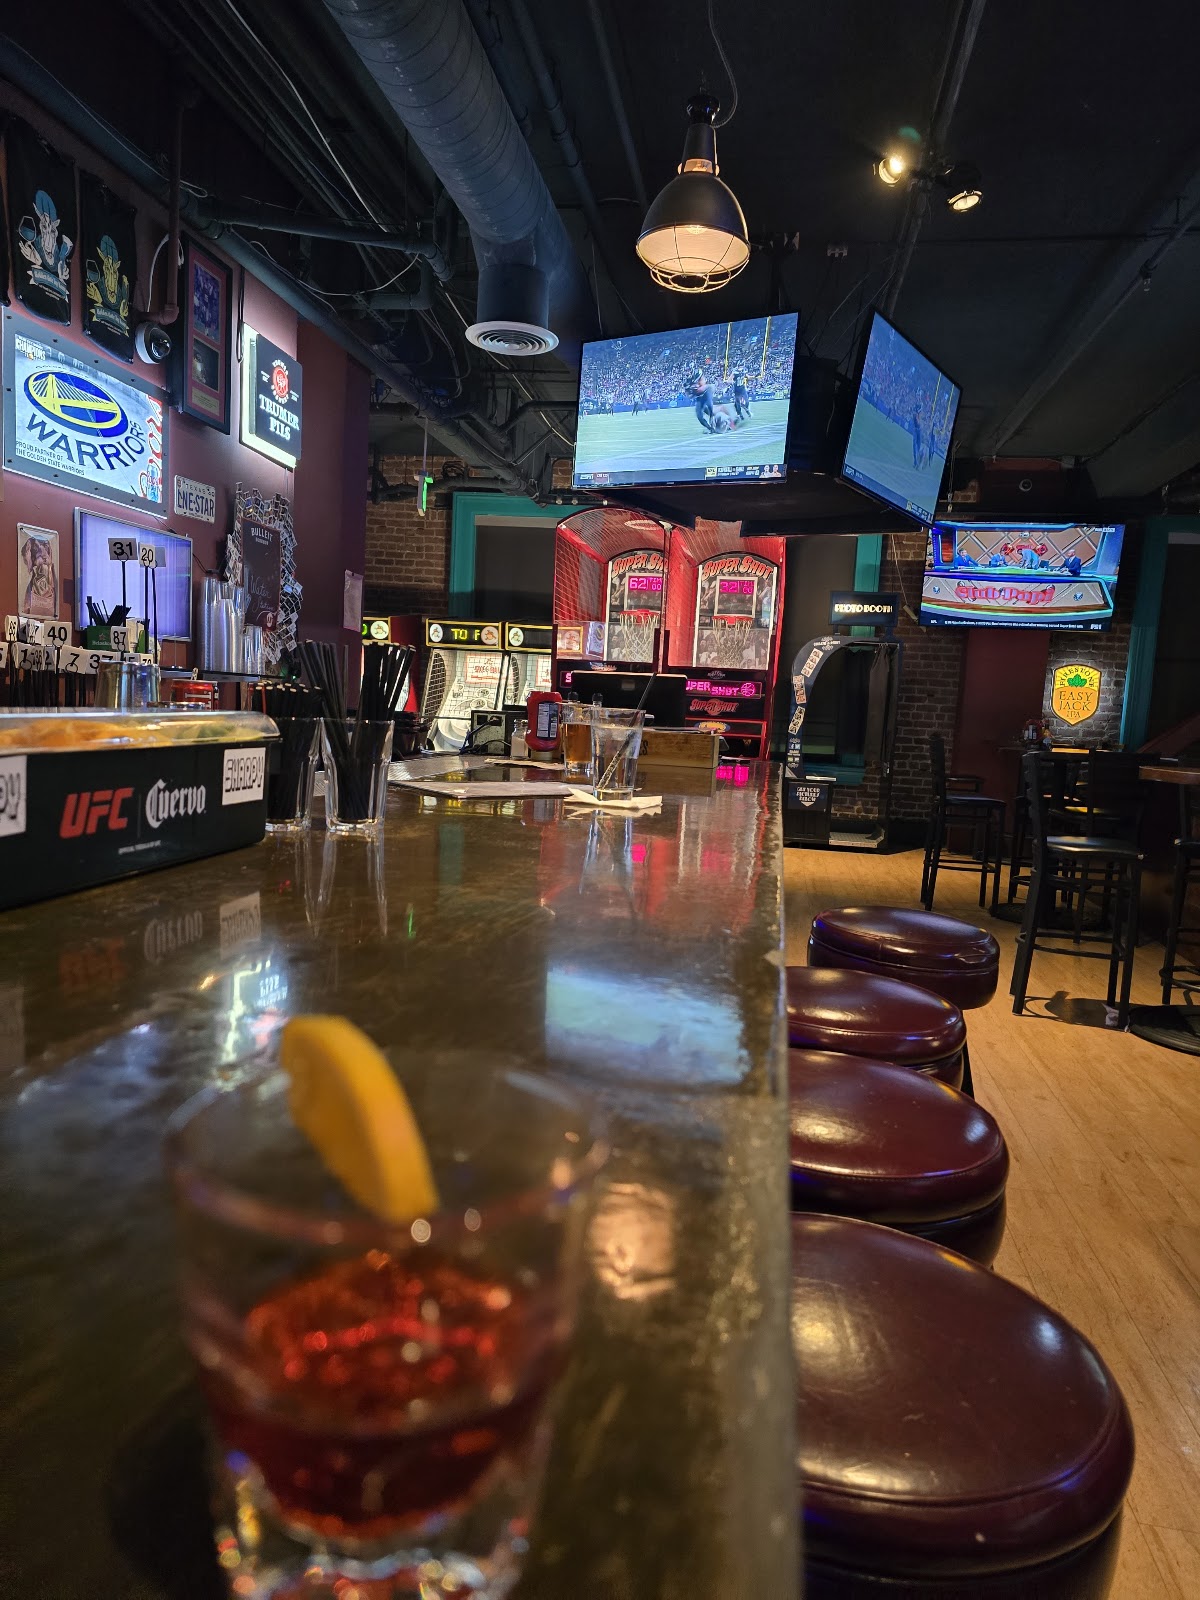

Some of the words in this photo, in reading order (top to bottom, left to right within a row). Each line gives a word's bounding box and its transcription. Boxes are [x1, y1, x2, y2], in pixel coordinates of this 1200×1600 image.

[258, 394, 300, 430] TRUMER
[269, 416, 291, 440] PILS
[16, 441, 33, 451] PROUD
[26, 420, 147, 470] WARRIORS
[16, 447, 25, 456] THE
[48, 458, 61, 468] STATE
[250, 527, 273, 542] BULLEIT
[113, 541, 133, 556] 31
[141, 547, 154, 563] 20
[611, 555, 648, 579] SUPER
[702, 557, 741, 581] SUPER
[739, 556, 774, 581] SHOT
[629, 577, 647, 589] 62
[720, 581, 738, 593] 32
[834, 603, 863, 613] PHOTO
[864, 604, 892, 613] BOOTH
[47, 625, 68, 642] 40
[112, 630, 127, 646] 87
[451, 628, 467, 640] TO
[70, 652, 80, 667] 7
[1060, 667, 1095, 687] FIRESTONE
[711, 686, 739, 696] SHOT
[1059, 690, 1093, 702] EASY
[1057, 700, 1092, 712] JACK
[1066, 710, 1081, 718] IPA
[224, 757, 264, 793] SHARPY
[59, 787, 134, 839] UFC
[145, 778, 206, 829] Cuervo
